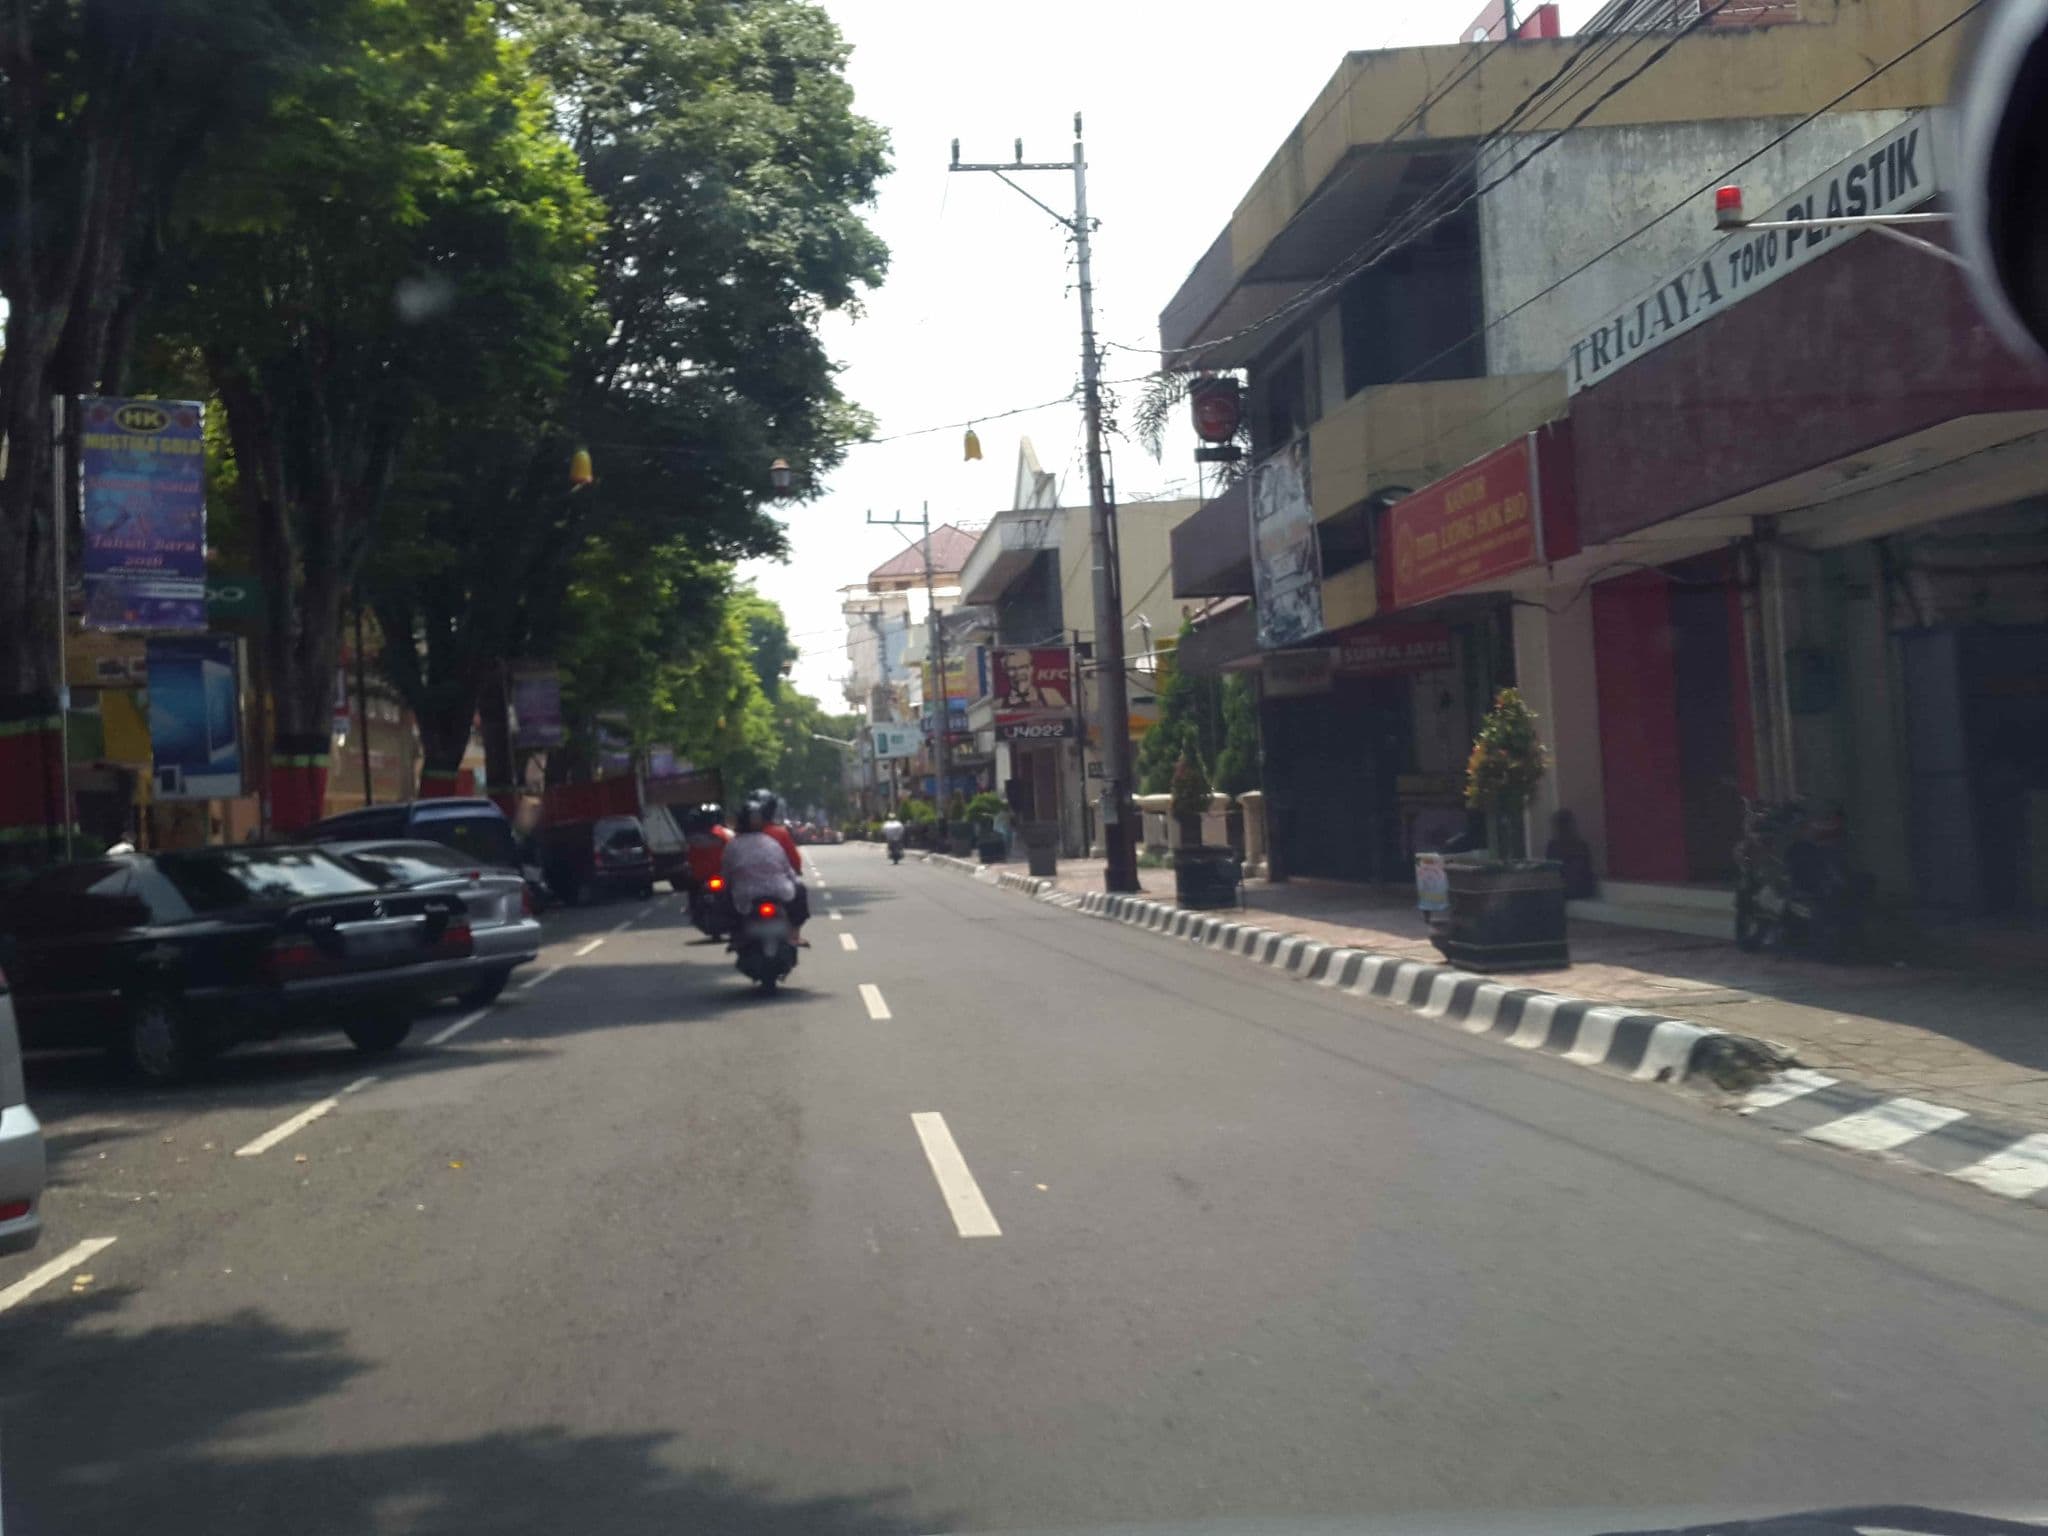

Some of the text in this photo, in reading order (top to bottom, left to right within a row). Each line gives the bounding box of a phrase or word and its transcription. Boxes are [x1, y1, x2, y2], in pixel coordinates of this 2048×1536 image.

[1569, 127, 1920, 385] TRIJAYA TOKO PLASTIK
[1037, 668, 1068, 681] KFC
